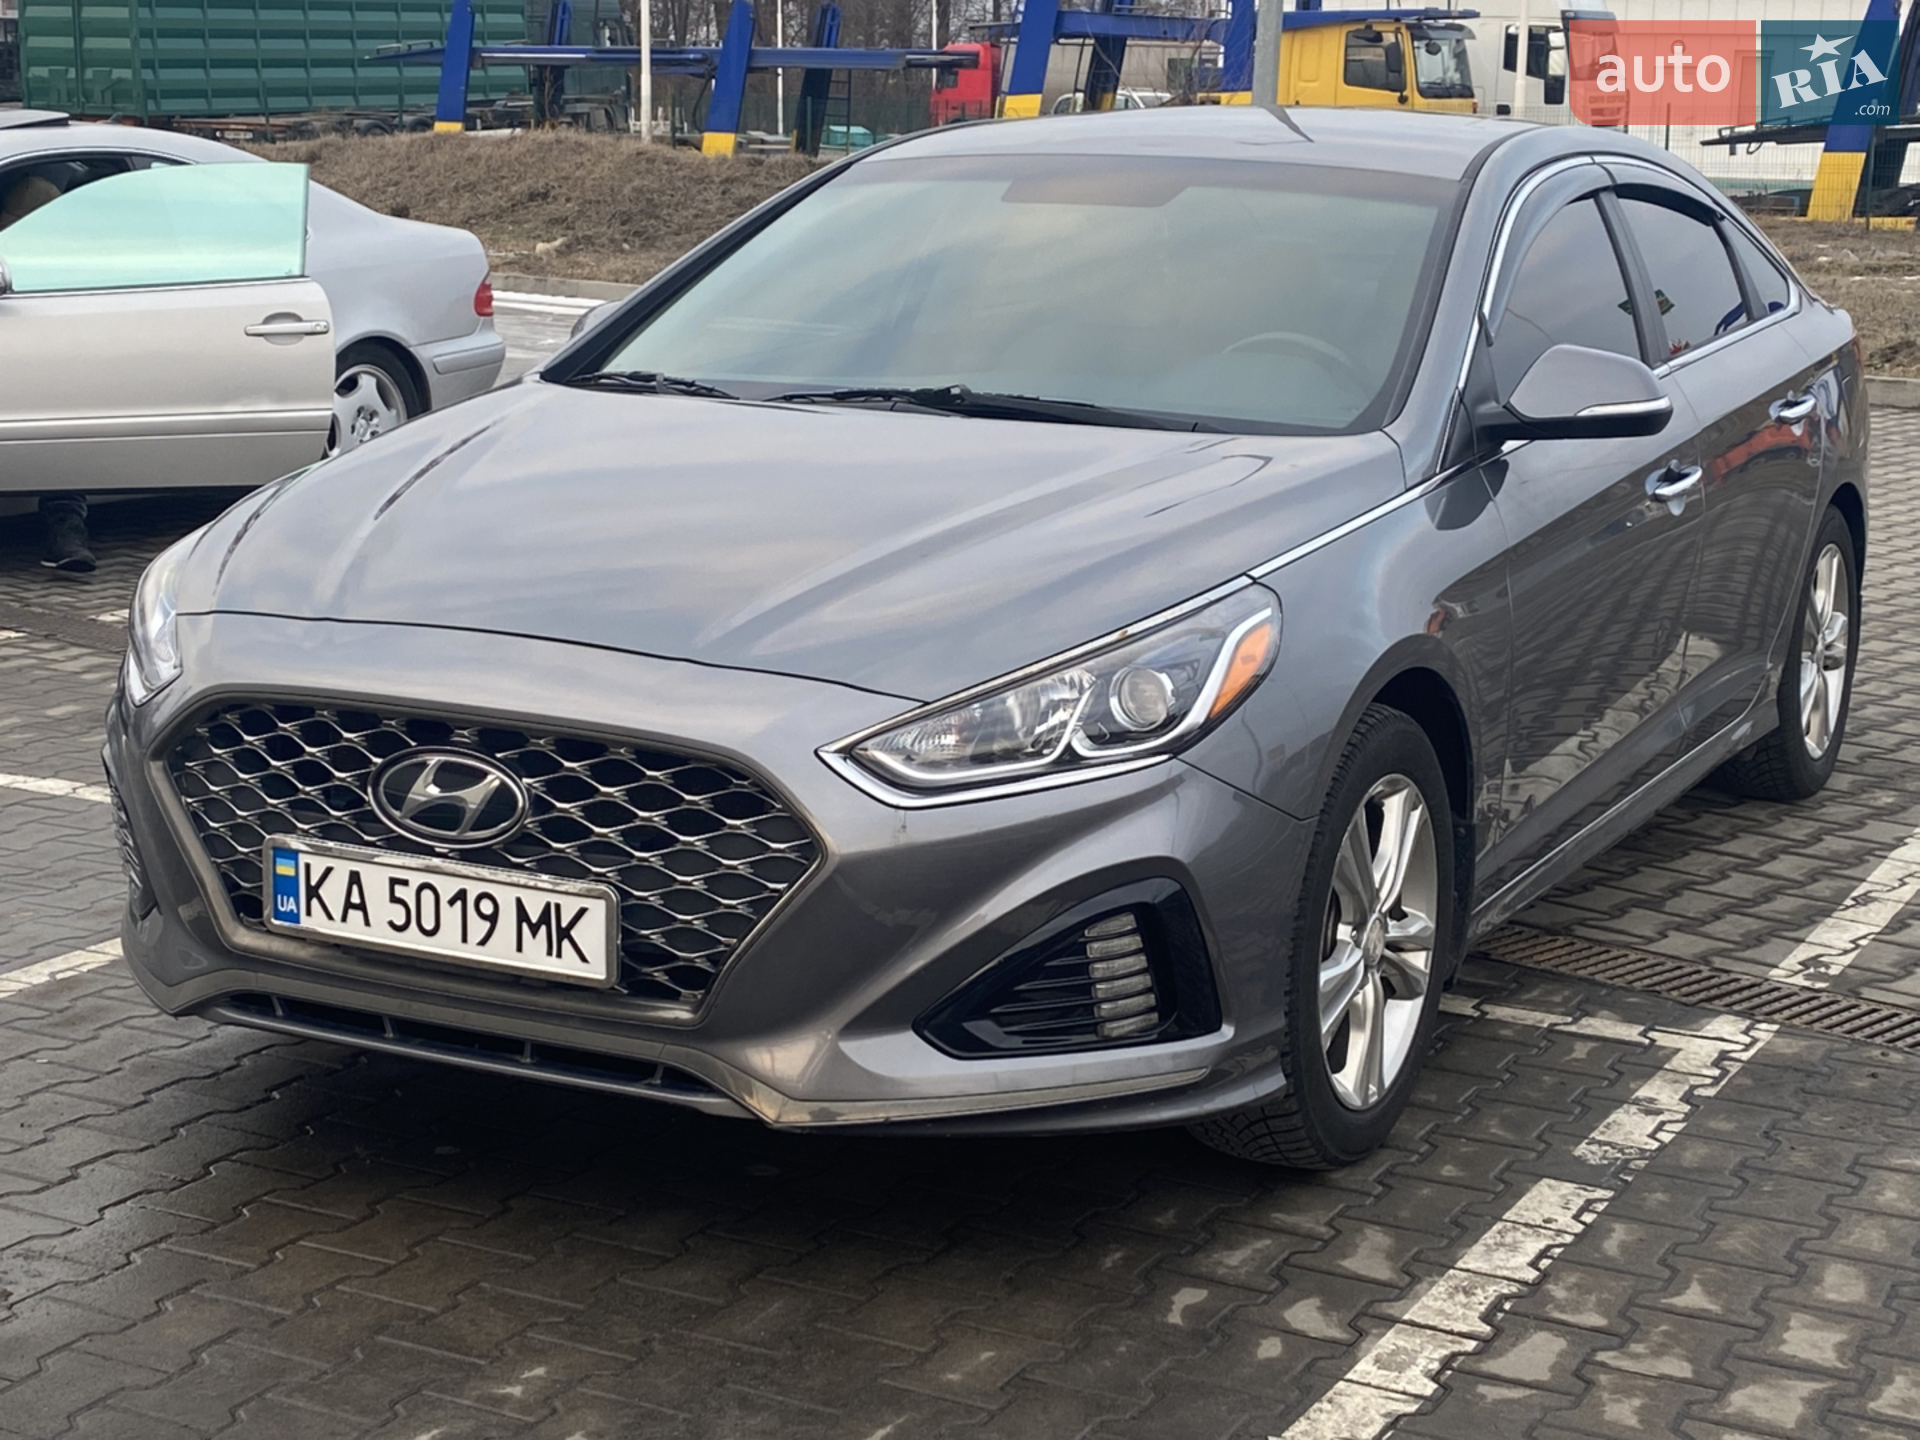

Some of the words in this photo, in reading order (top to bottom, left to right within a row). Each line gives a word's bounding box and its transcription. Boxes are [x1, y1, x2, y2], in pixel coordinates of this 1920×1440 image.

[277, 894, 298, 914] UA
[304, 862, 371, 927] KA
[387, 876, 500, 947] 5019
[514, 896, 590, 964] MK
